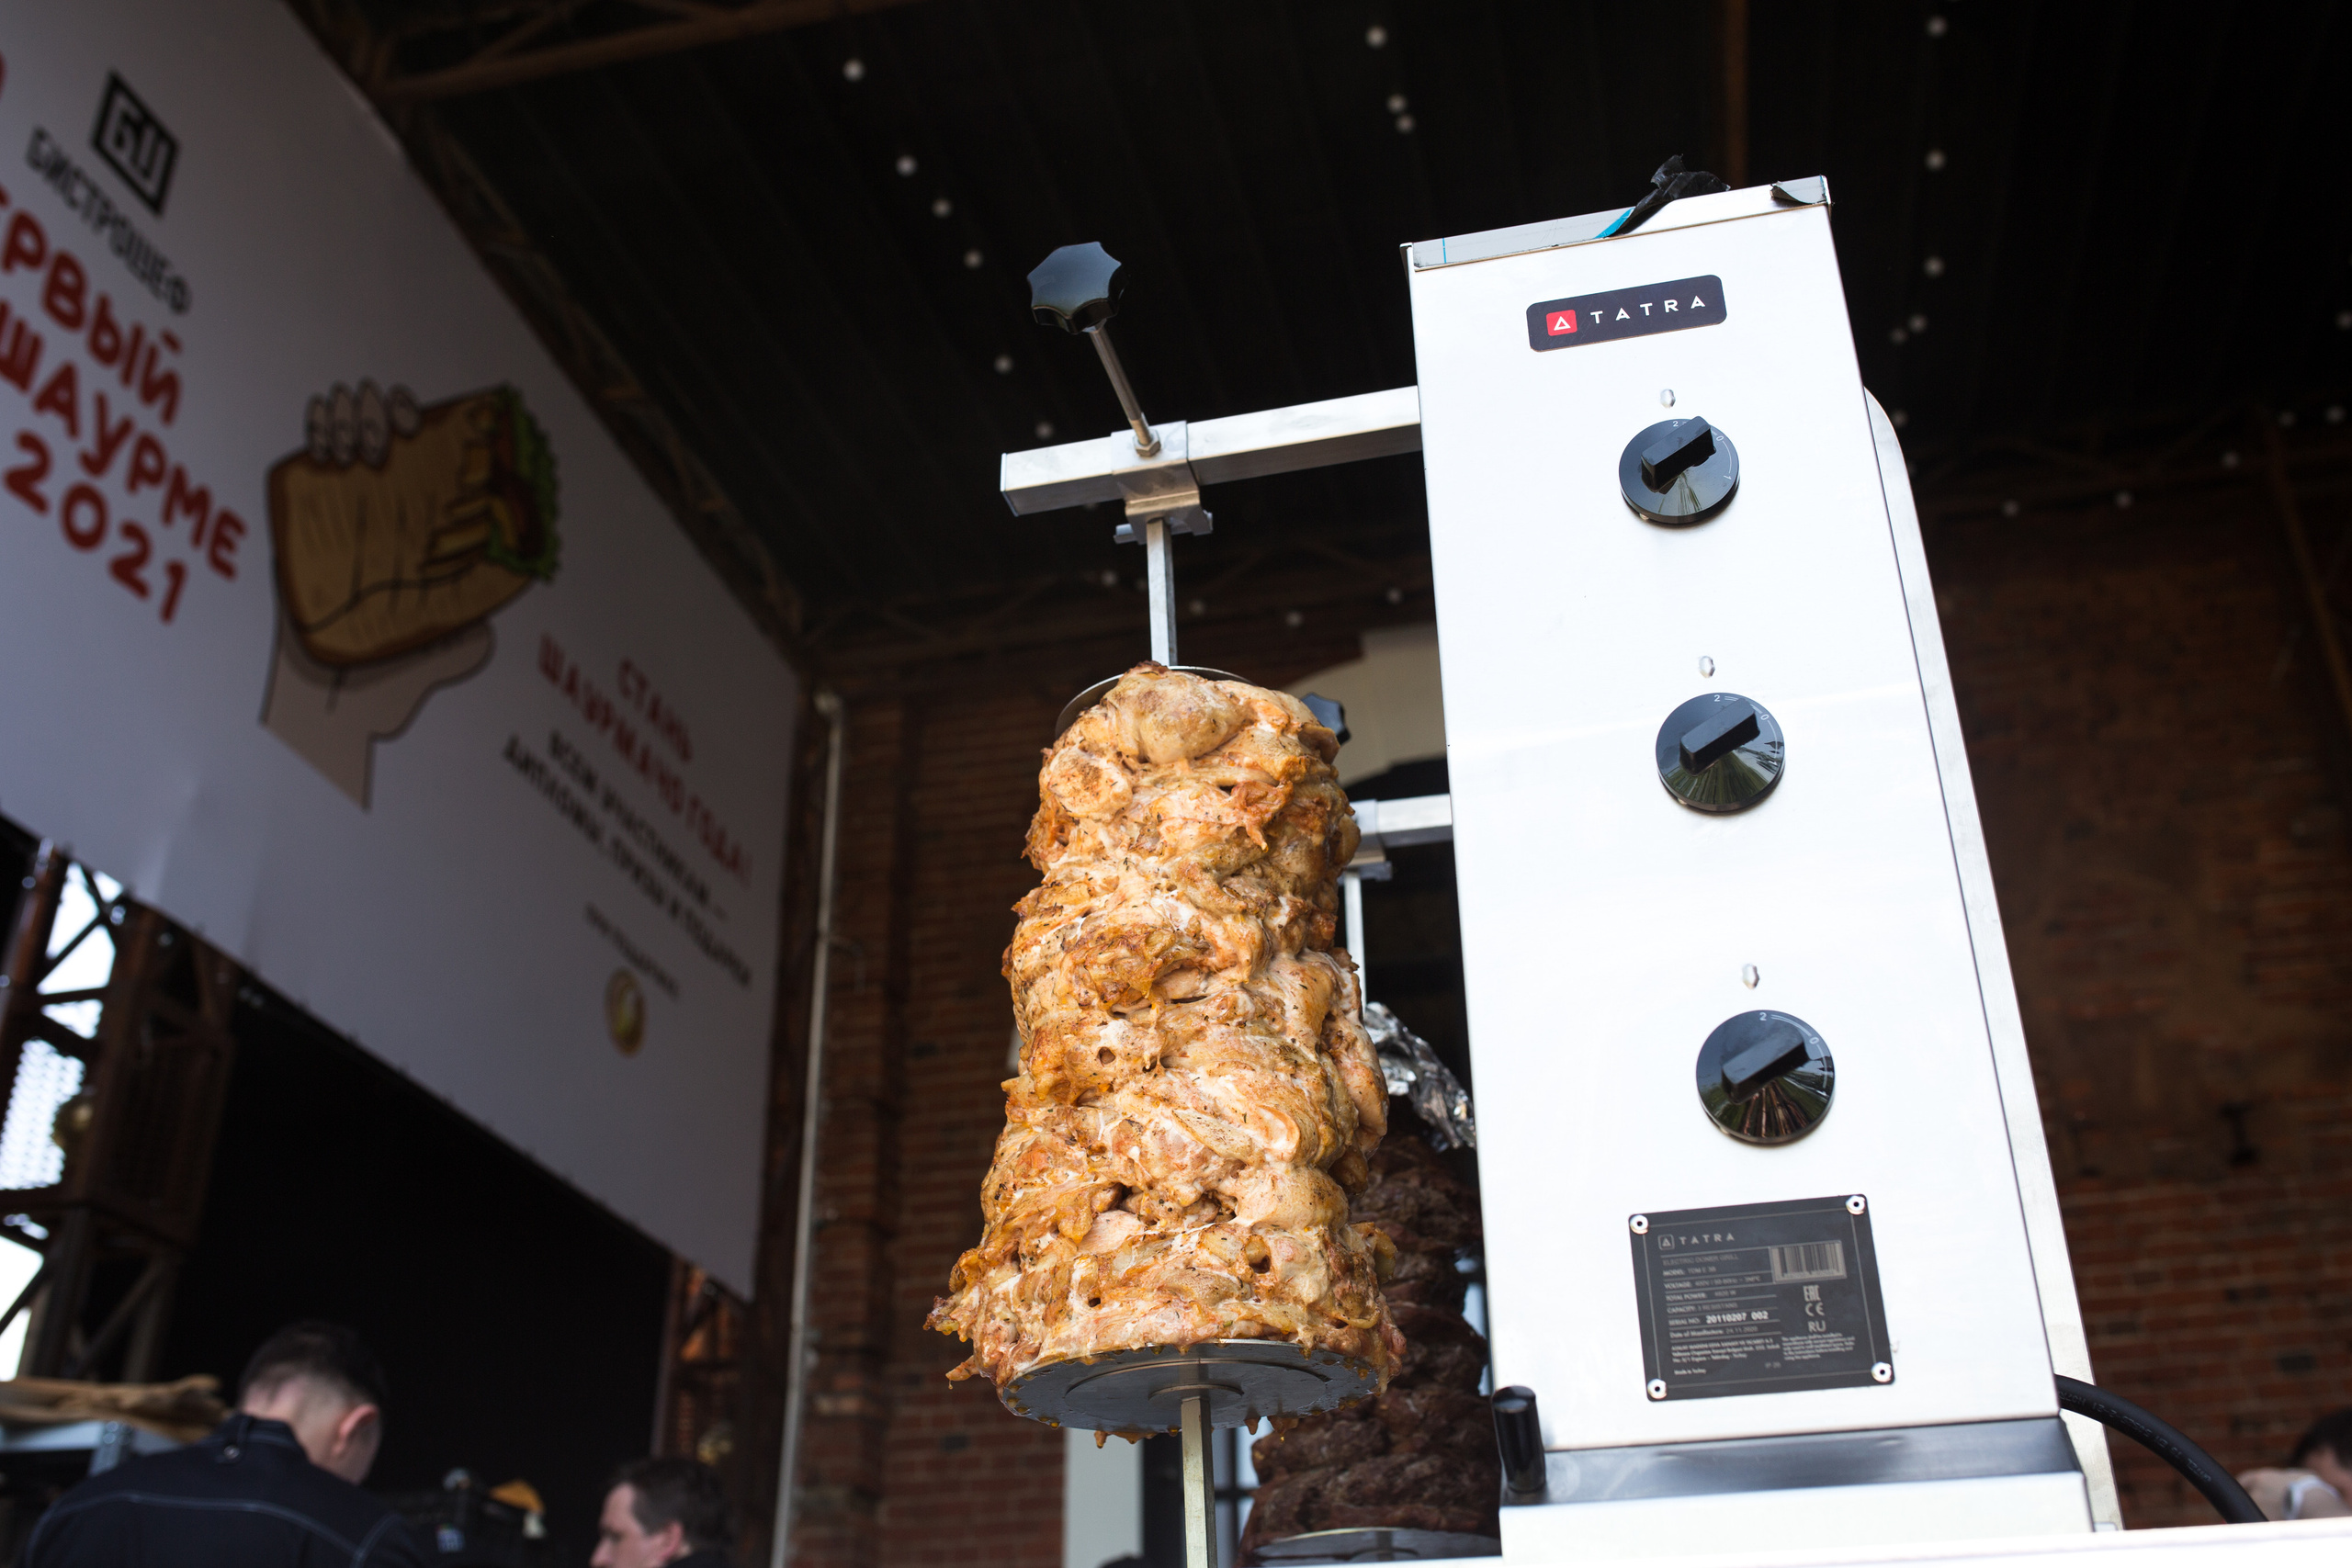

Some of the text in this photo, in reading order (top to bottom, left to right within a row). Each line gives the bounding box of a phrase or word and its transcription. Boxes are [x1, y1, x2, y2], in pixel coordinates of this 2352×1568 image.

[0, 187, 182, 427] РВЫЙ
[1590, 295, 1706, 324] TATRA
[3, 429, 187, 624] 2021
[1713, 694, 1721, 702] 2
[1759, 1011, 1768, 1021] 2
[1809, 1036, 1819, 1044] 0
[1679, 1233, 1735, 1246] TATRA
[1706, 1312, 1747, 1324] 20110207
[1751, 1310, 1769, 1320] 002
[1807, 1320, 1826, 1333] RU
